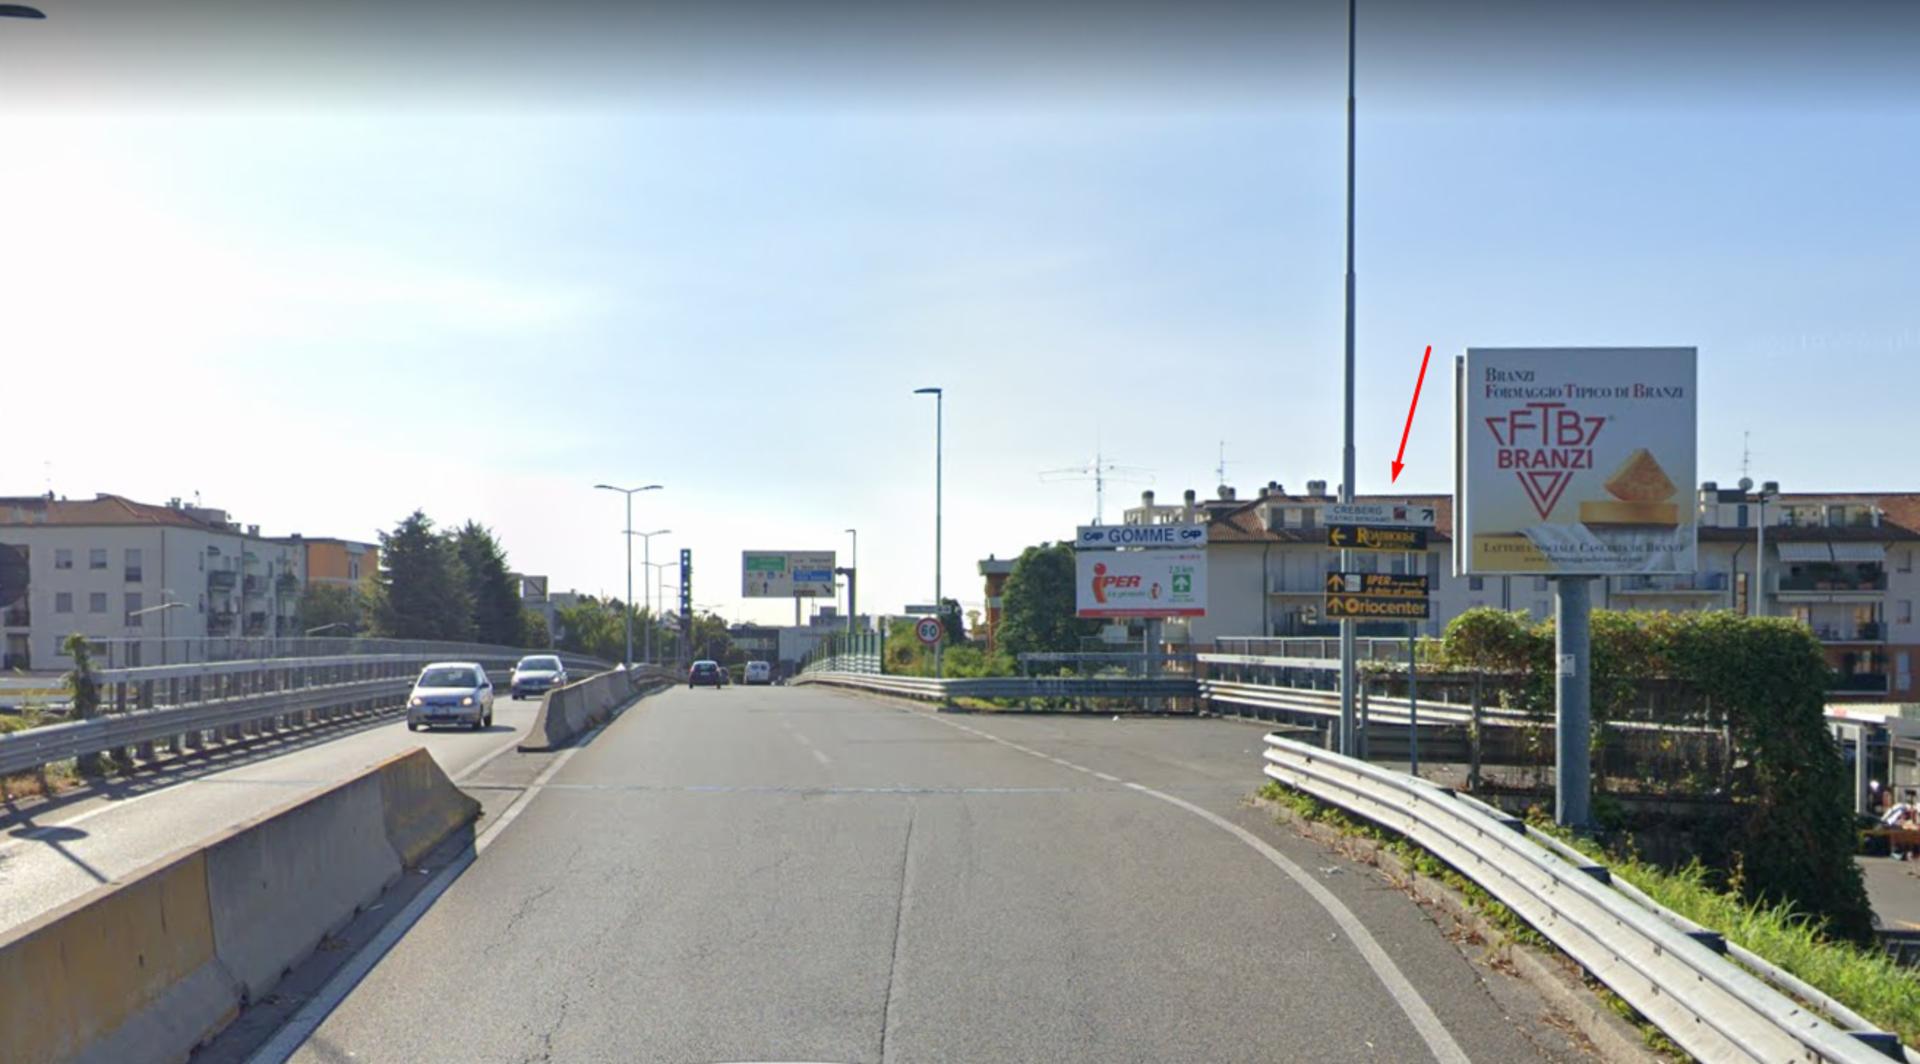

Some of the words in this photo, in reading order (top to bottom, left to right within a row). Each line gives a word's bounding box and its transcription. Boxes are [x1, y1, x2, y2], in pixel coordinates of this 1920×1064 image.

[1485, 366, 1535, 382] BRANZI
[1485, 383, 1562, 399] FORMAGGIO
[1563, 383, 1612, 399] TIPICO
[1632, 383, 1684, 399] BRANZI
[1498, 449, 1593, 469] BRANZI
[1108, 528, 1175, 543] GOMME
[1345, 598, 1426, 614] Oriocenter
[921, 624, 938, 637] 60
